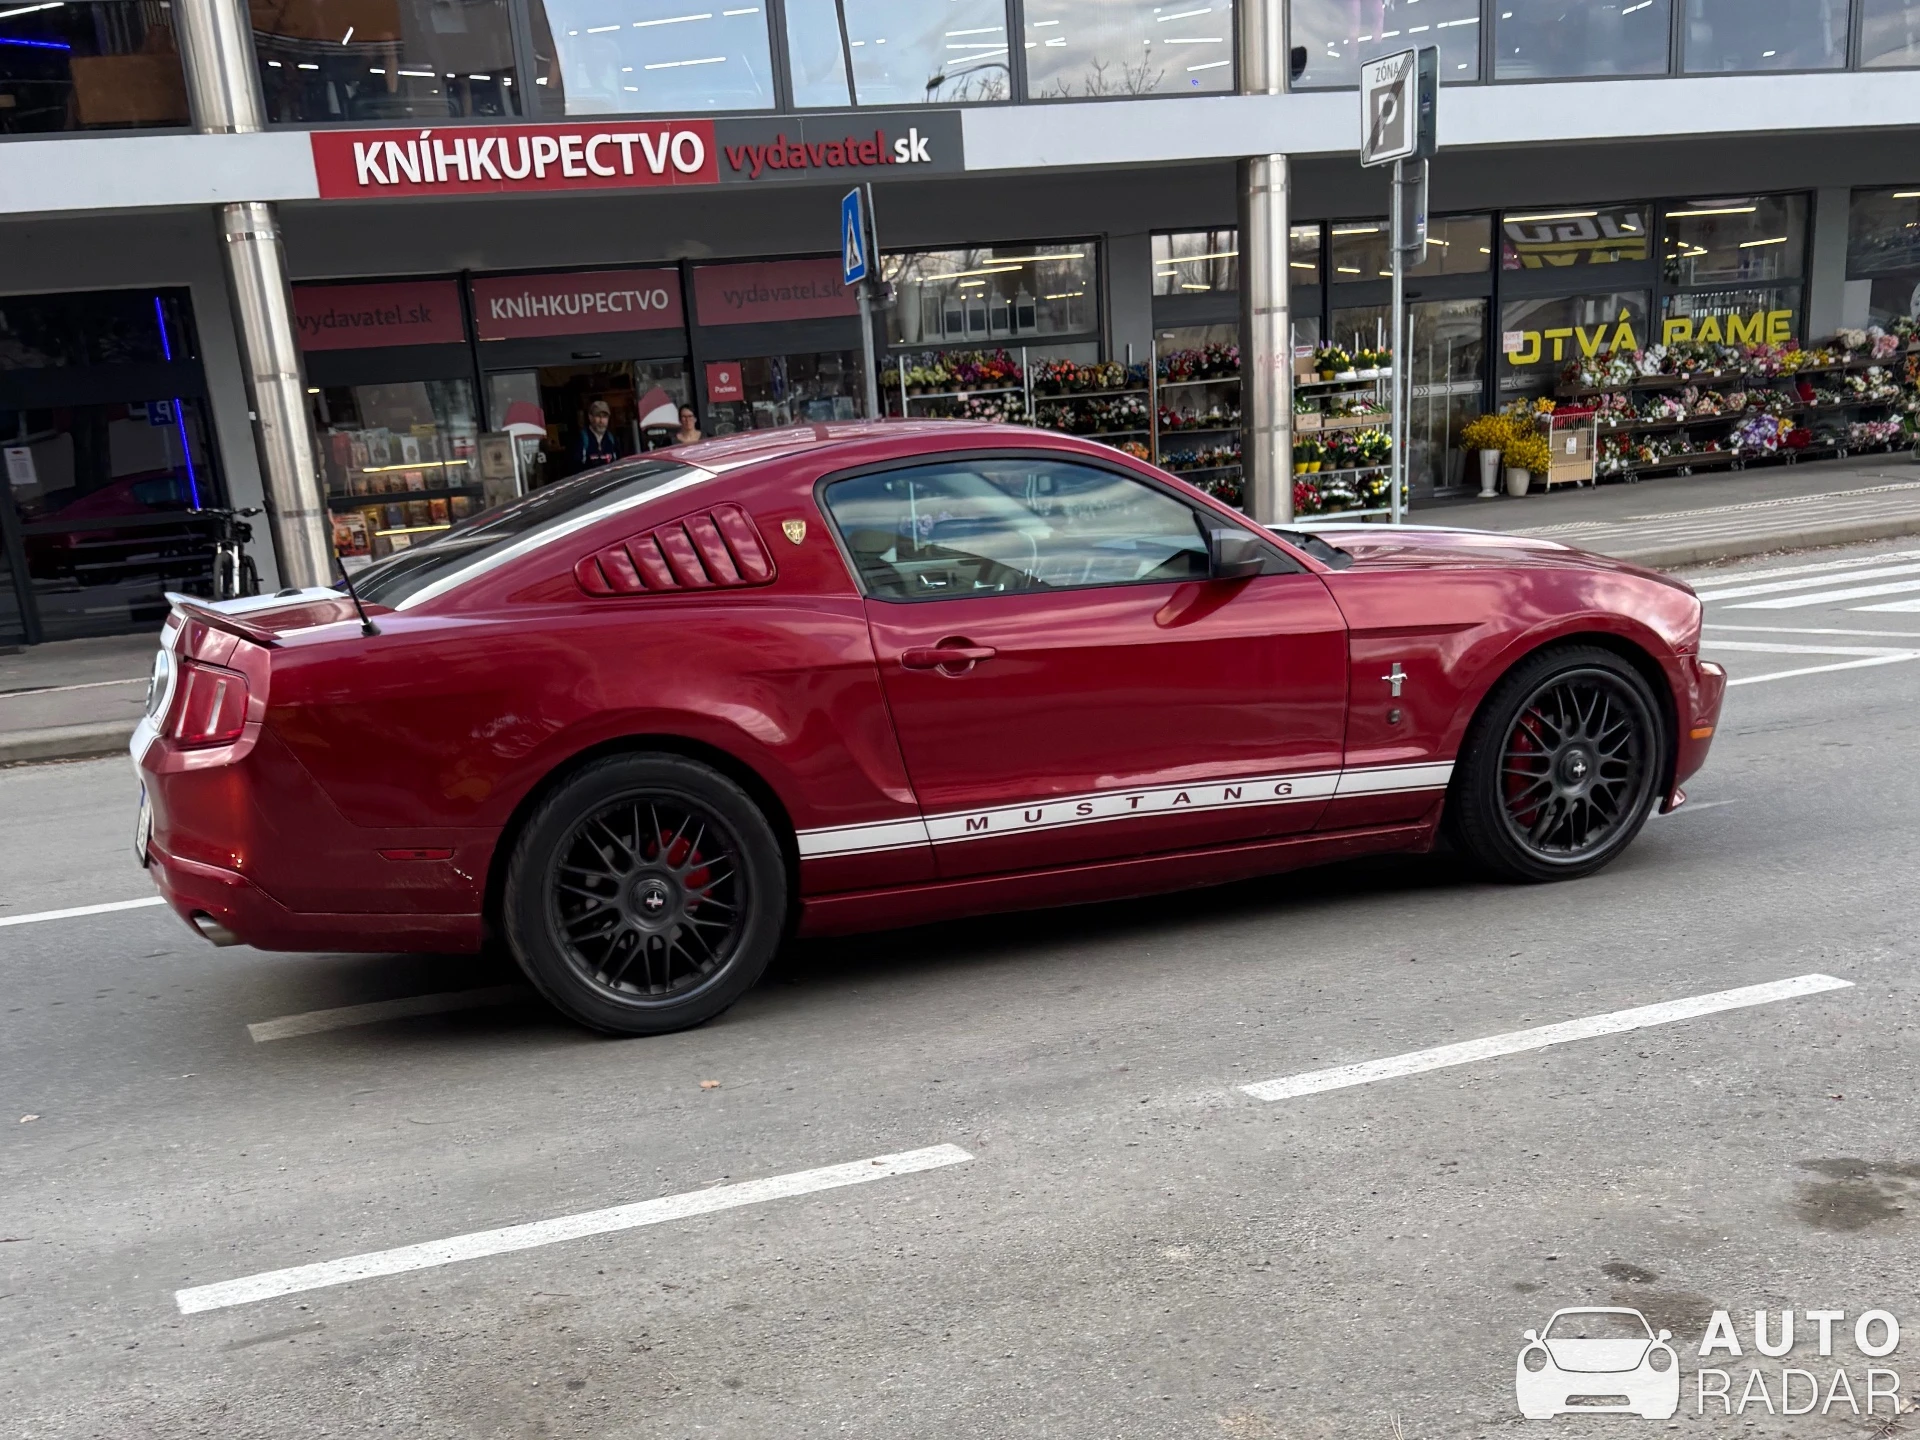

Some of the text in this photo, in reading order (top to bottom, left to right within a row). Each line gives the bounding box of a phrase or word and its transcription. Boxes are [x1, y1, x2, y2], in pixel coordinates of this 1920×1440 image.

[1375, 62, 1399, 83] ZÓNA
[352, 130, 705, 185] KNÍHKUPECTVO
[725, 127, 931, 179] vydavatel.sk
[490, 289, 669, 319] KNÍHKUPECTVO
[723, 280, 843, 309] vydavatel.sk
[965, 782, 1293, 832] MUSTANG
